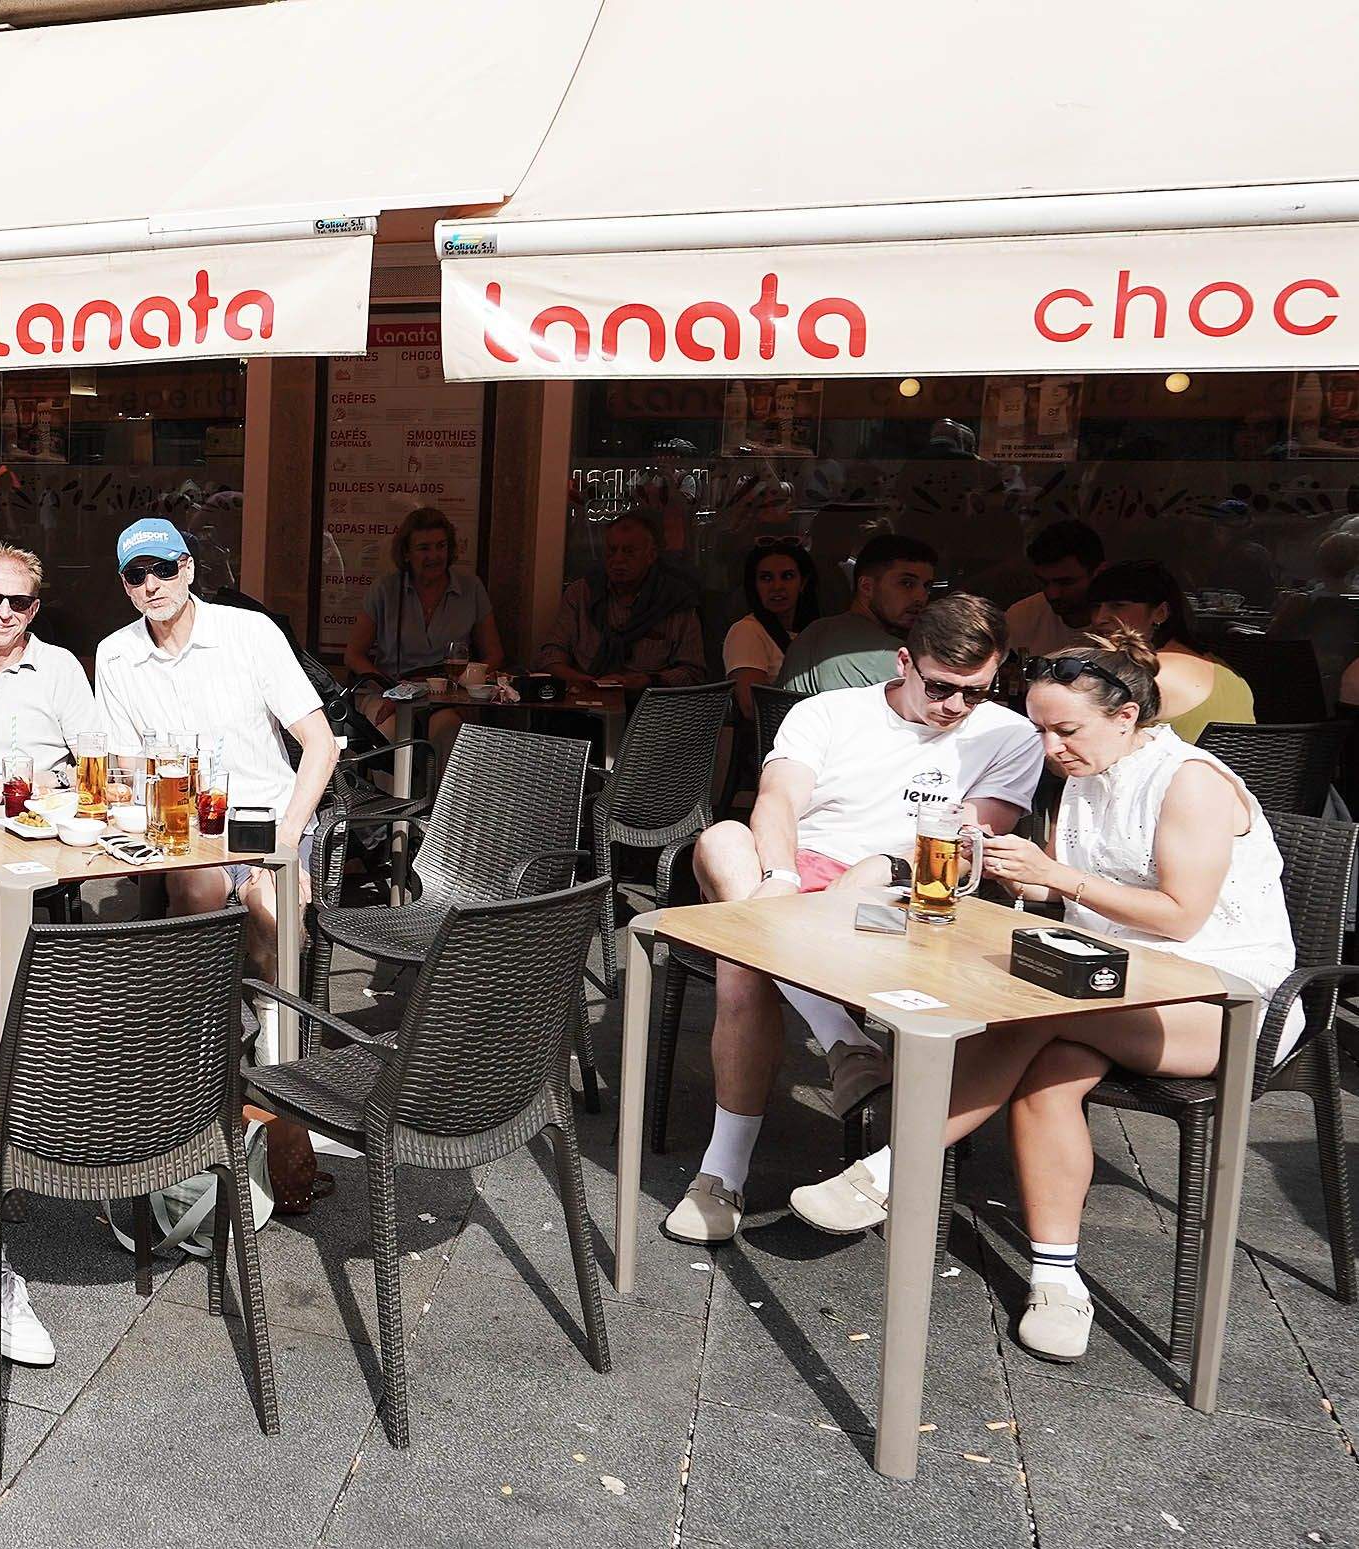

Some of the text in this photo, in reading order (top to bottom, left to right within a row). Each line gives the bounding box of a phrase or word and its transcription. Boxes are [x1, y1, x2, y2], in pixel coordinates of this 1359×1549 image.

[1033, 270, 1339, 343] choc
[484, 272, 867, 363] Lanata
[375, 326, 438, 343] Lanata
[330, 428, 367, 440] CAFÉS
[407, 430, 476, 441] SMOOTHIES
[329, 482, 444, 494] DULCES Y SALADOS
[327, 523, 365, 534] COPAS
[325, 574, 372, 586] FRAPPÉS
